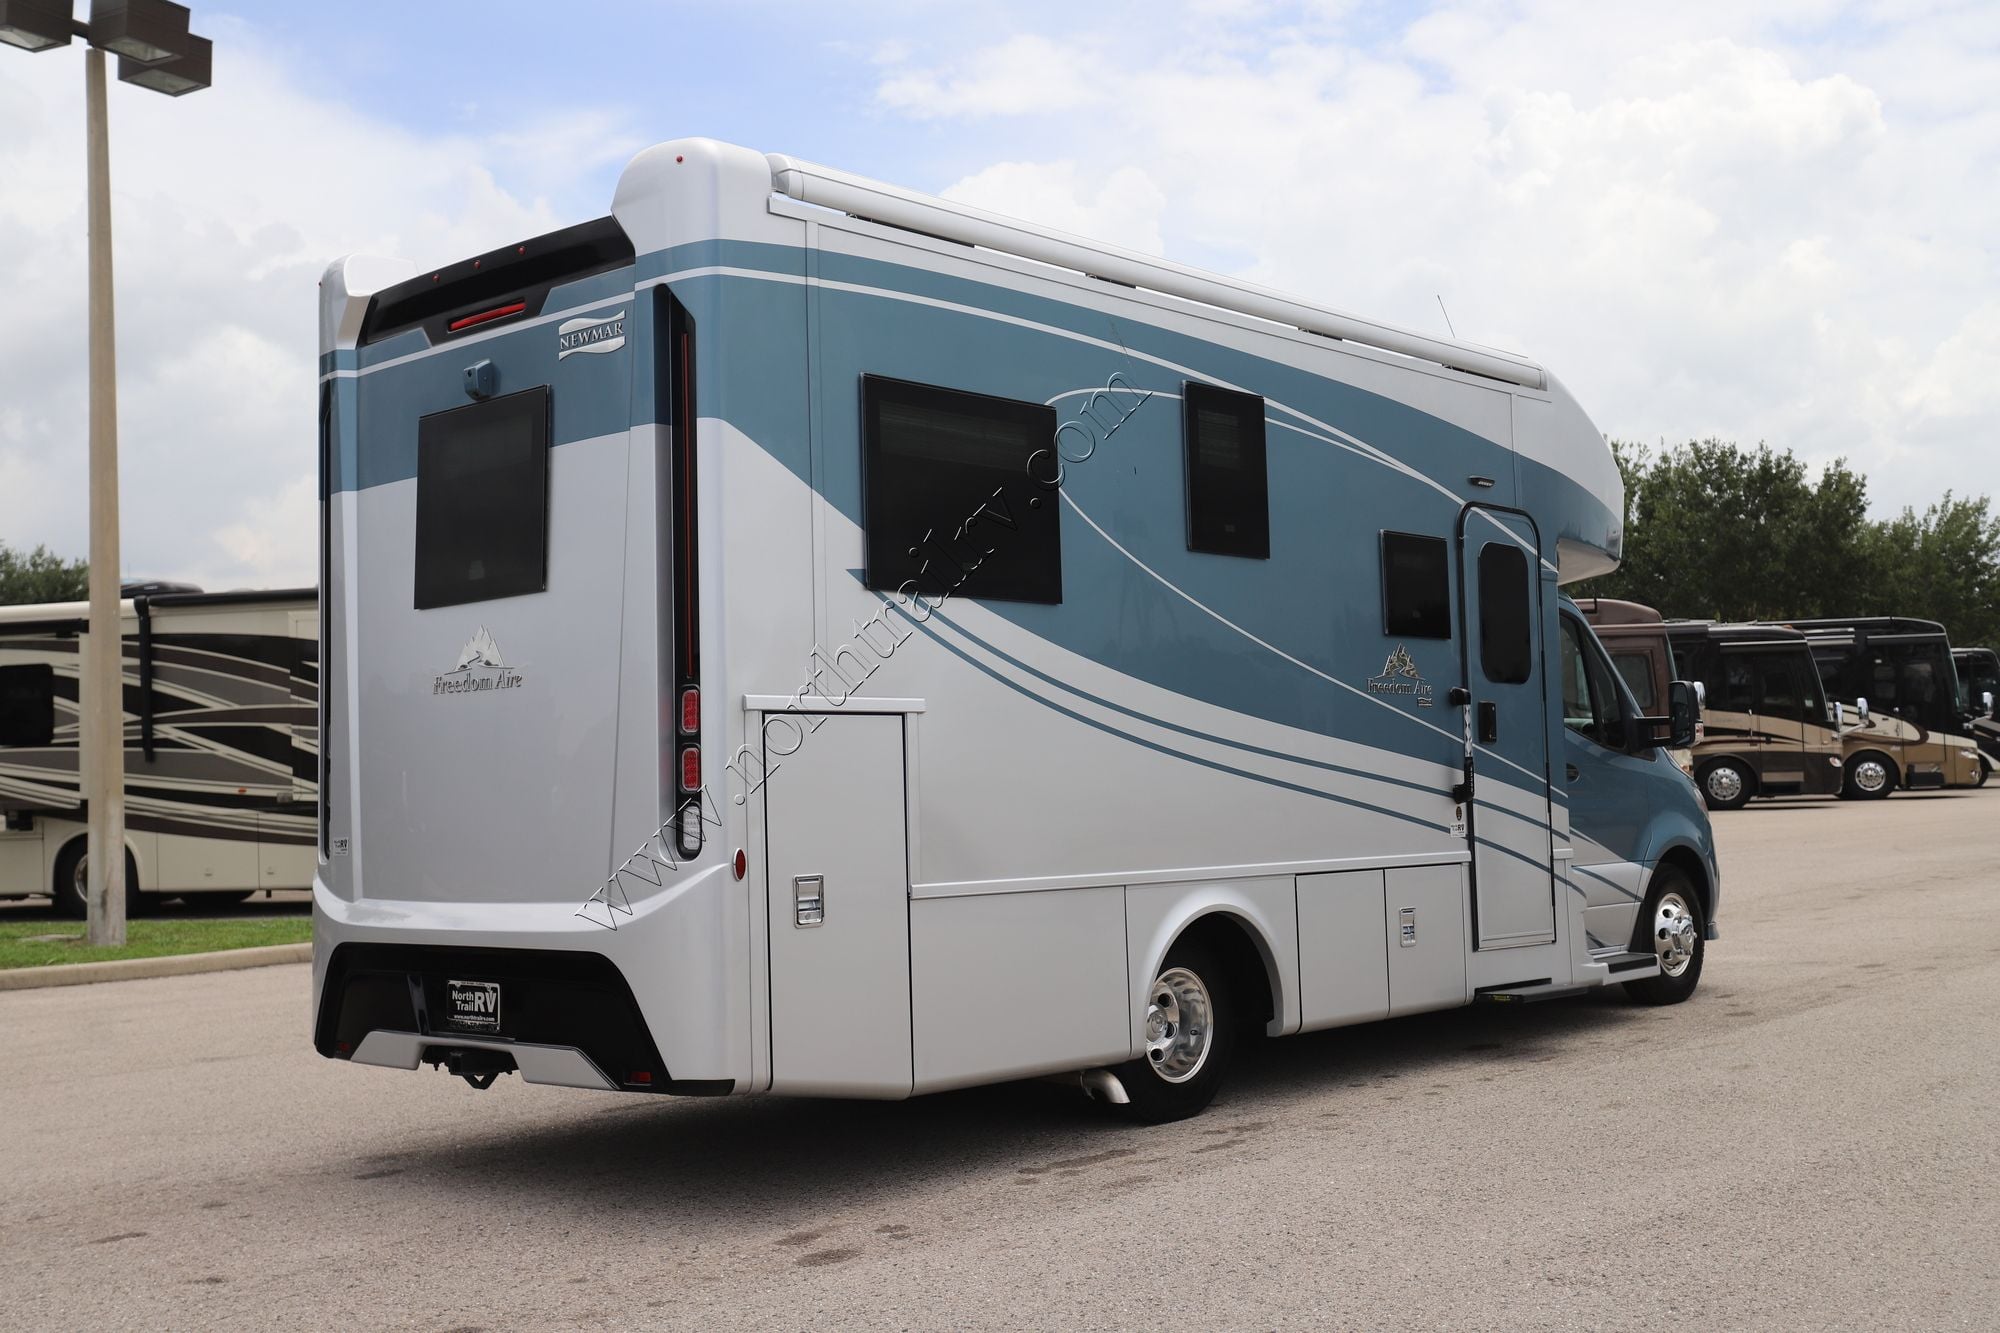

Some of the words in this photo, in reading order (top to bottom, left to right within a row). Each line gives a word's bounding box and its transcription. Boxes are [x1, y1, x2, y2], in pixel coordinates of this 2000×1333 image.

[560, 323, 624, 349] NEWMAR
[433, 672, 493, 695] Freedom
[495, 669, 522, 690] Aire
[1367, 677, 1411, 695] Freedom
[1413, 680, 1432, 695] Aire
[452, 990, 474, 1001] North
[474, 991, 497, 1013] RV
[455, 1001, 474, 1012] Trail
